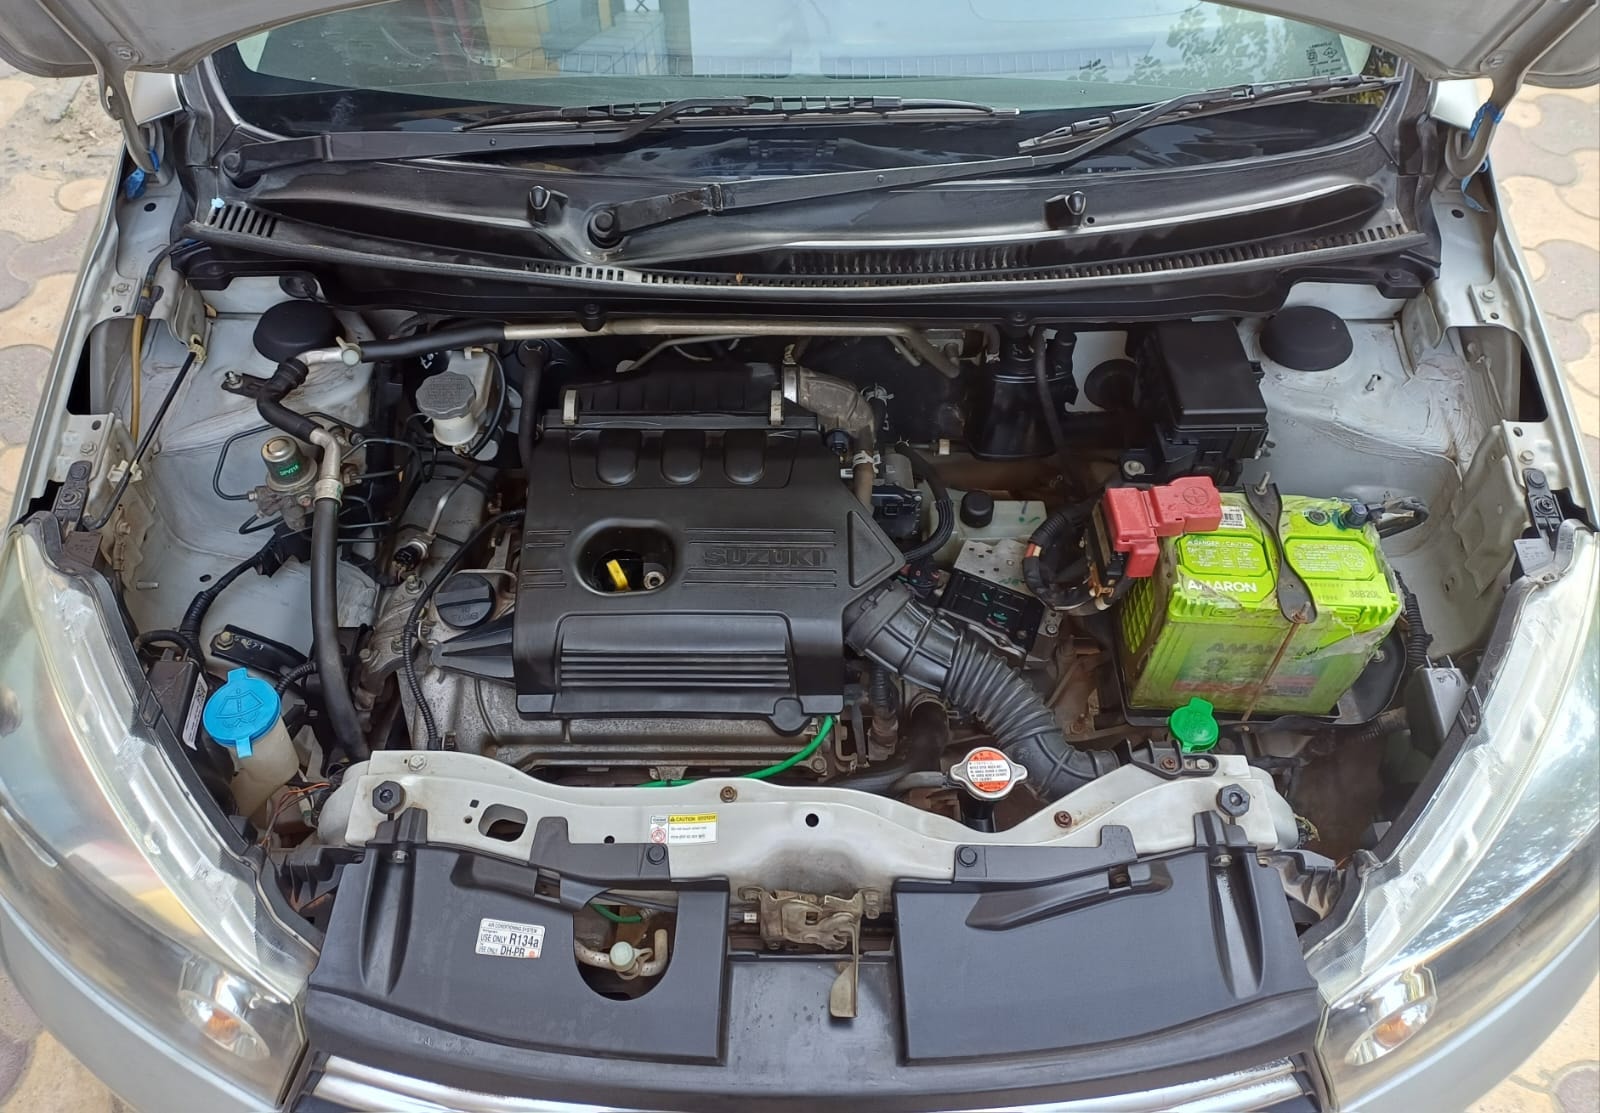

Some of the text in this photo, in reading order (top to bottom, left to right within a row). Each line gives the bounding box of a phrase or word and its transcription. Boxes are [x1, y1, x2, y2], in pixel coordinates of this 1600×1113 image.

[703, 548, 824, 568] SUZUKI
[1188, 580, 1257, 592] AMARON
[1349, 589, 1382, 599] 38B20L
[480, 933, 491, 942] USE
[492, 935, 508, 944] ONLY
[509, 933, 539, 948] R134a
[500, 945, 526, 957] DH-PR
